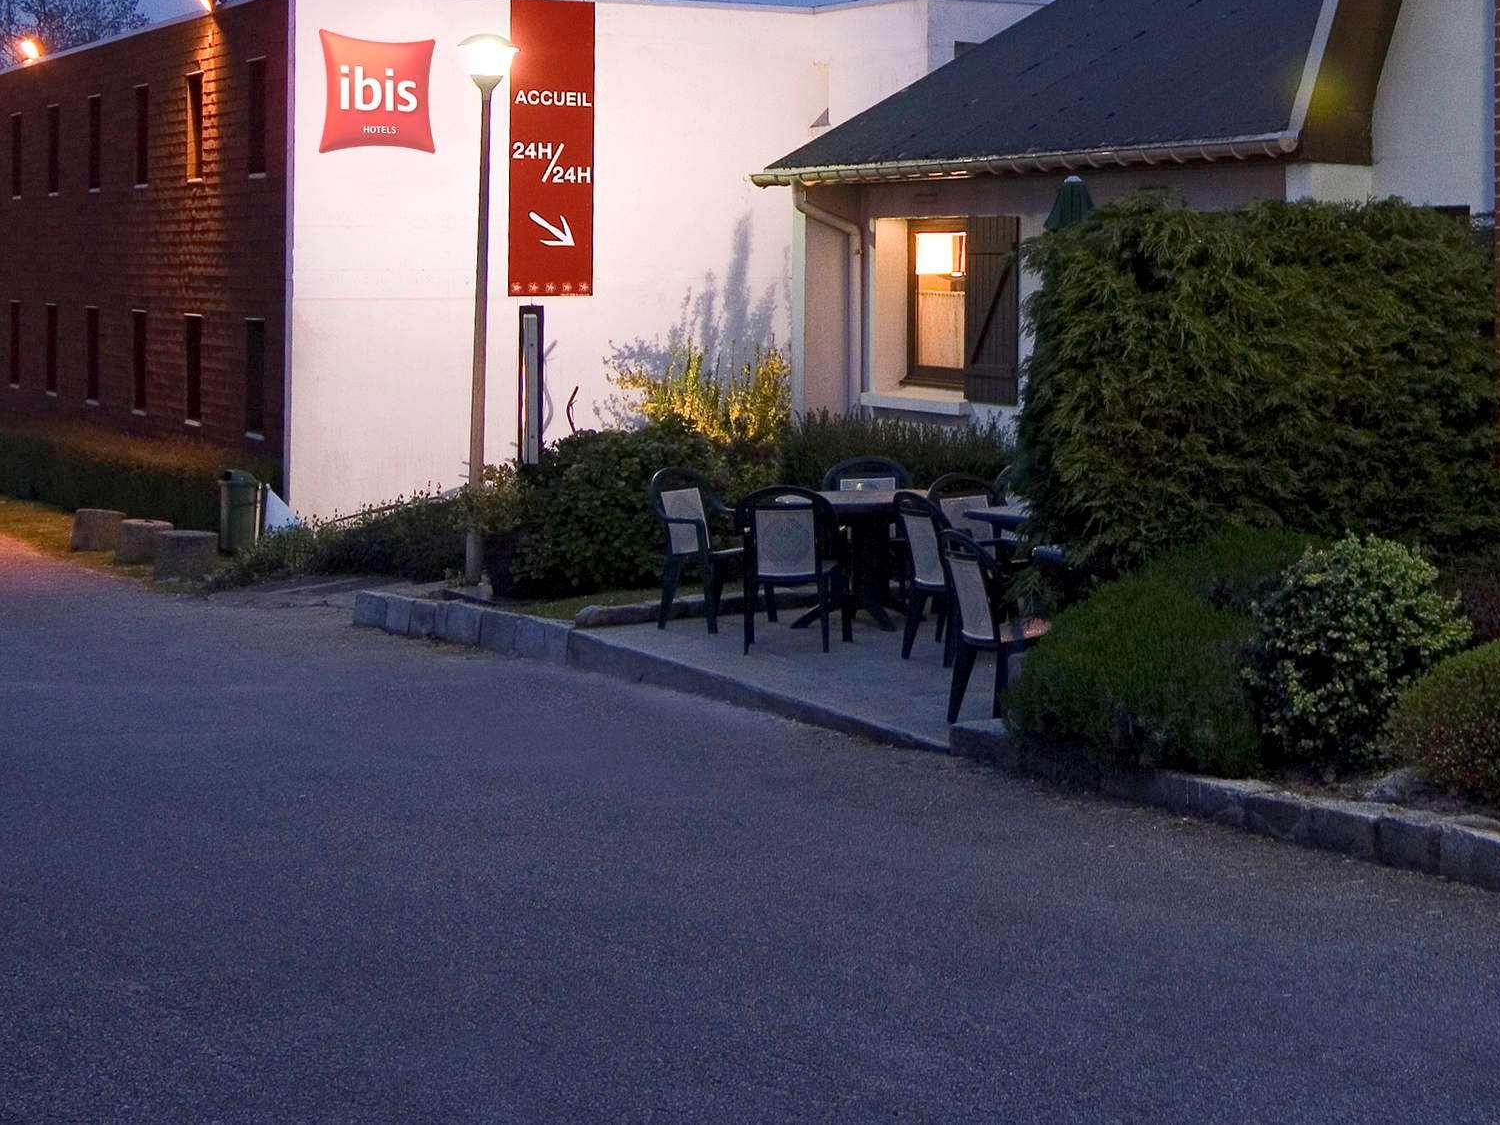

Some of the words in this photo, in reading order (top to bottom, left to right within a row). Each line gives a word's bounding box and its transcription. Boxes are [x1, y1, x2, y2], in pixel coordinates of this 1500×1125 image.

[340, 65, 418, 113] ibis
[514, 89, 592, 107] ACCUEIL
[363, 125, 398, 135] HOTELS
